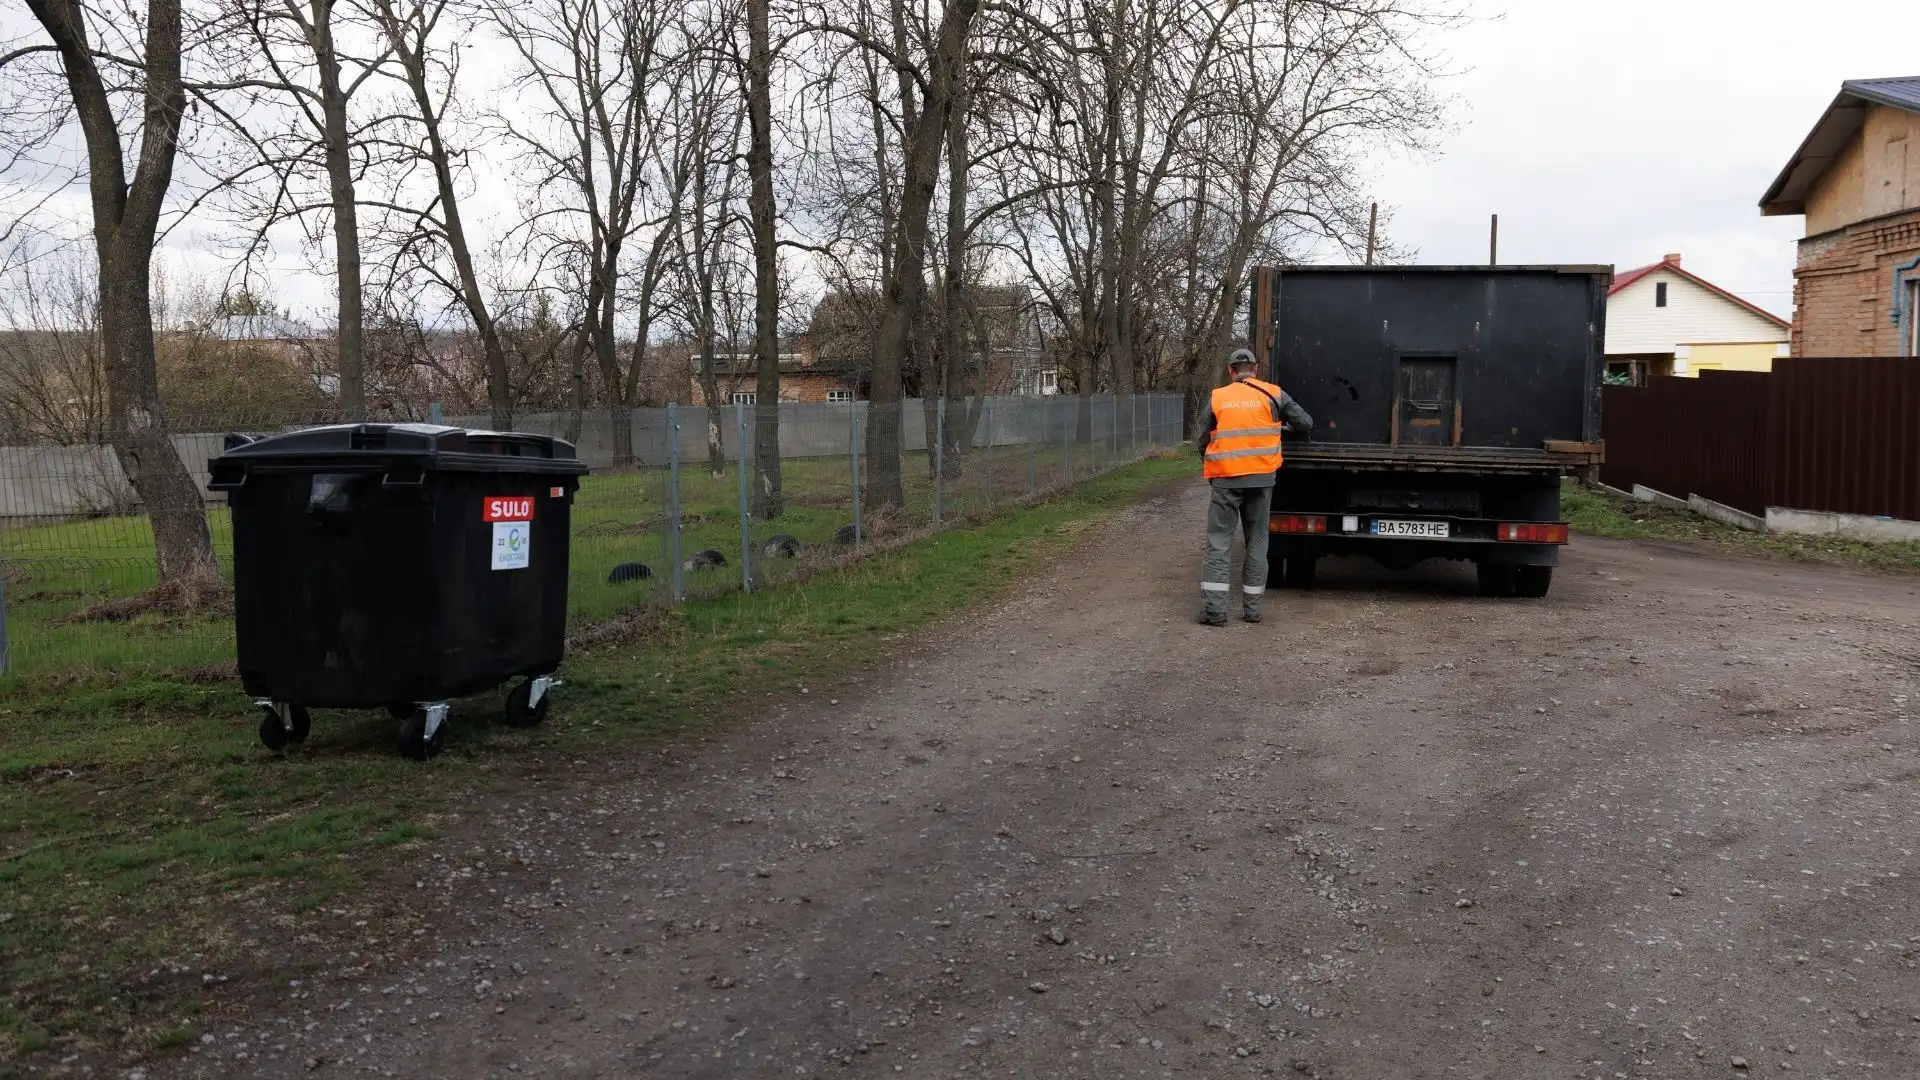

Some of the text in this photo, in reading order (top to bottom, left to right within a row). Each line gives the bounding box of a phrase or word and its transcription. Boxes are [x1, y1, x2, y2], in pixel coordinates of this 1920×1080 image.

[490, 500, 529, 517] SULO
[1379, 522, 1445, 535] BA 5783 HE
[498, 538, 505, 546] 22
